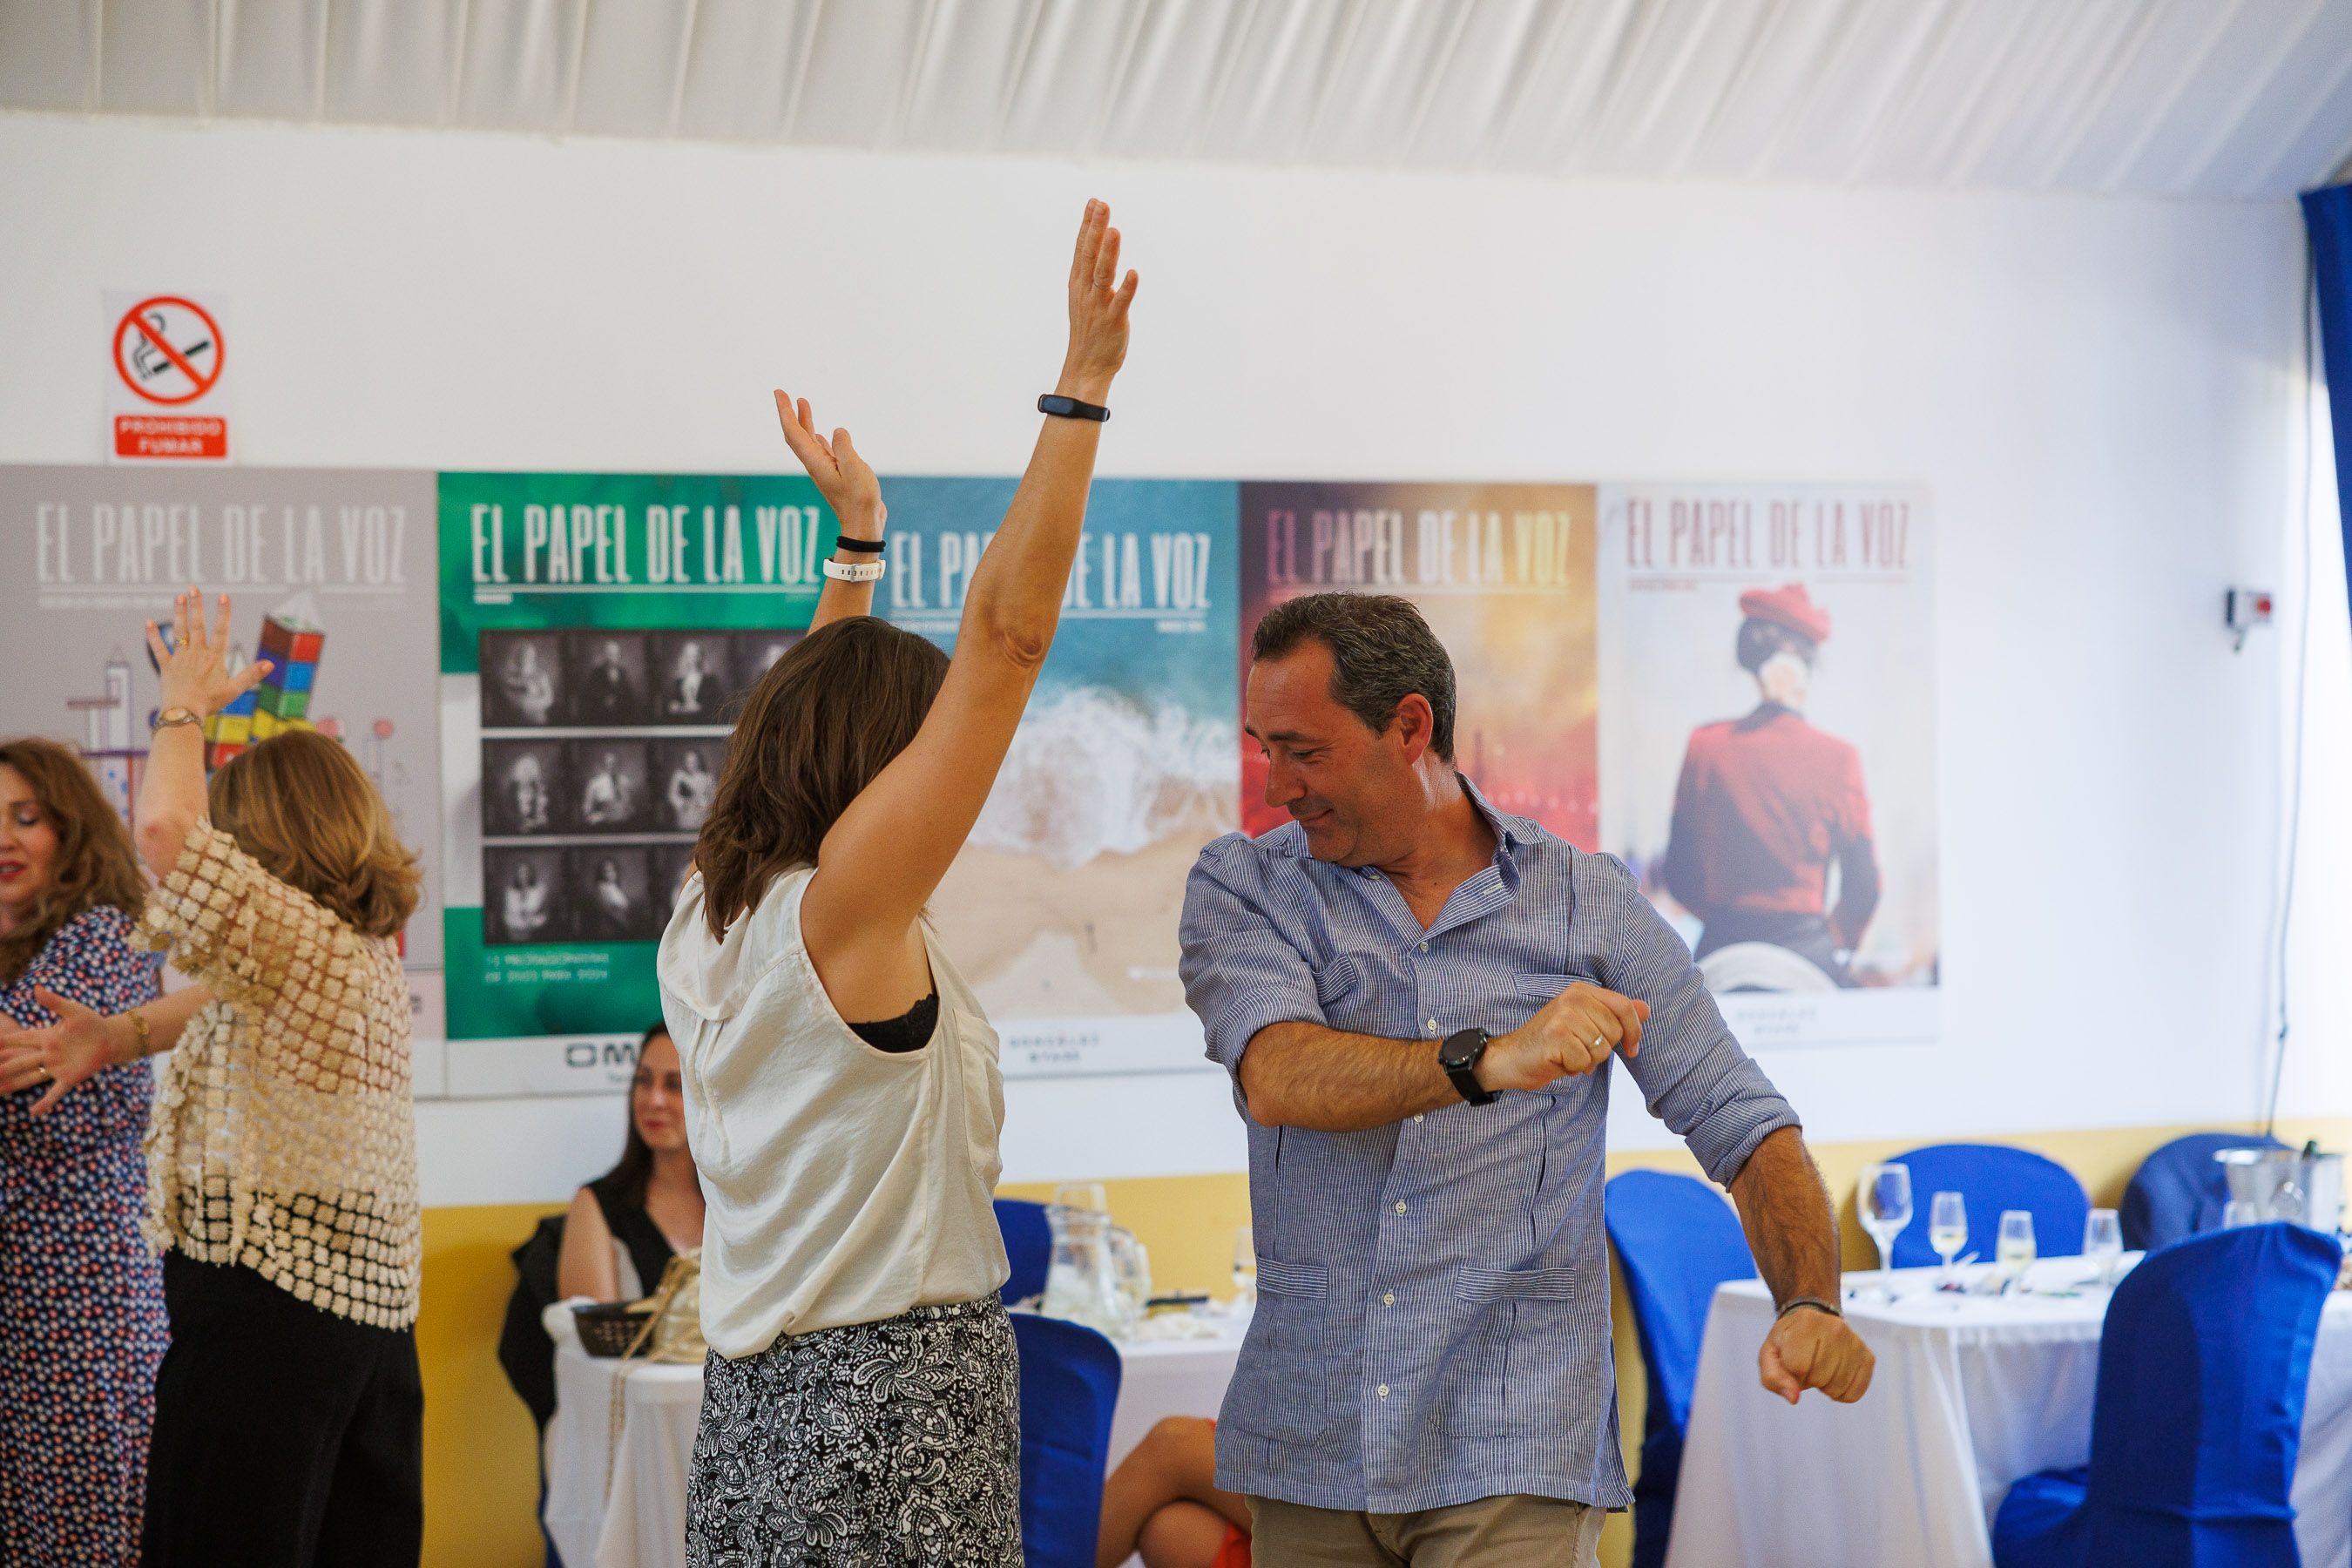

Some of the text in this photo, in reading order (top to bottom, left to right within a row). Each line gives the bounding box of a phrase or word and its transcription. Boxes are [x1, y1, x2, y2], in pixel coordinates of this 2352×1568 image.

[139, 436, 203, 453] FUMAR
[37, 504, 407, 583] EL PAPEL DE LA VOZ
[471, 504, 821, 583] EL PAPEL DE LA VOZ
[892, 531, 927, 608] EL
[1061, 532, 1093, 608] E
[1103, 532, 1142, 608] LA
[1151, 532, 1212, 609] VOZ
[1267, 510, 1570, 585] EL PAPEL DE LA VOZ
[1626, 498, 1910, 568] EL PAPEL DE LA VOZ
